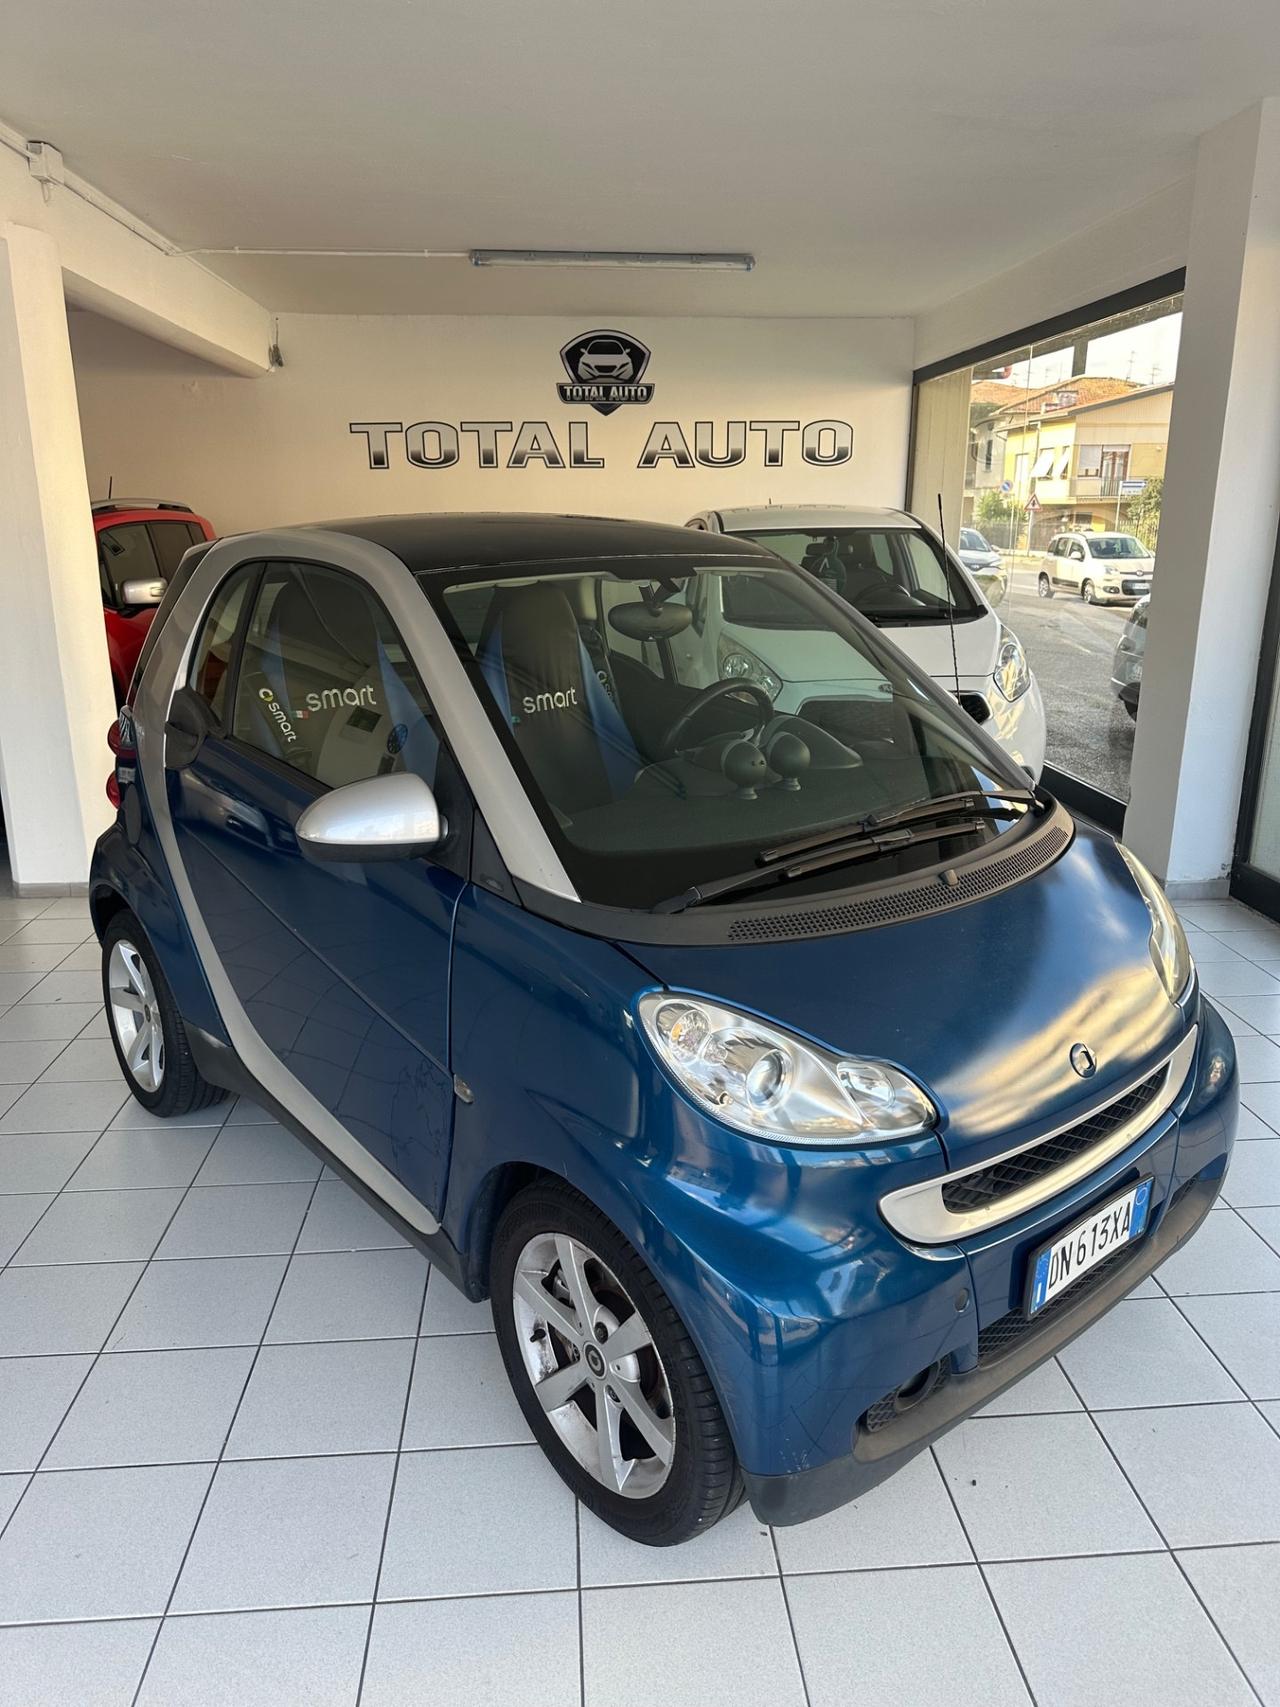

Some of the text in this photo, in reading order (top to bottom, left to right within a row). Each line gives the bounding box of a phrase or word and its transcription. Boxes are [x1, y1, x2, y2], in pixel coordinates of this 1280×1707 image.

[563, 386, 648, 401] TOTAL AUTO
[350, 419, 854, 469] TOTAL AUTO
[305, 684, 377, 712] smart
[522, 686, 578, 714] smart
[268, 701, 297, 743] smart
